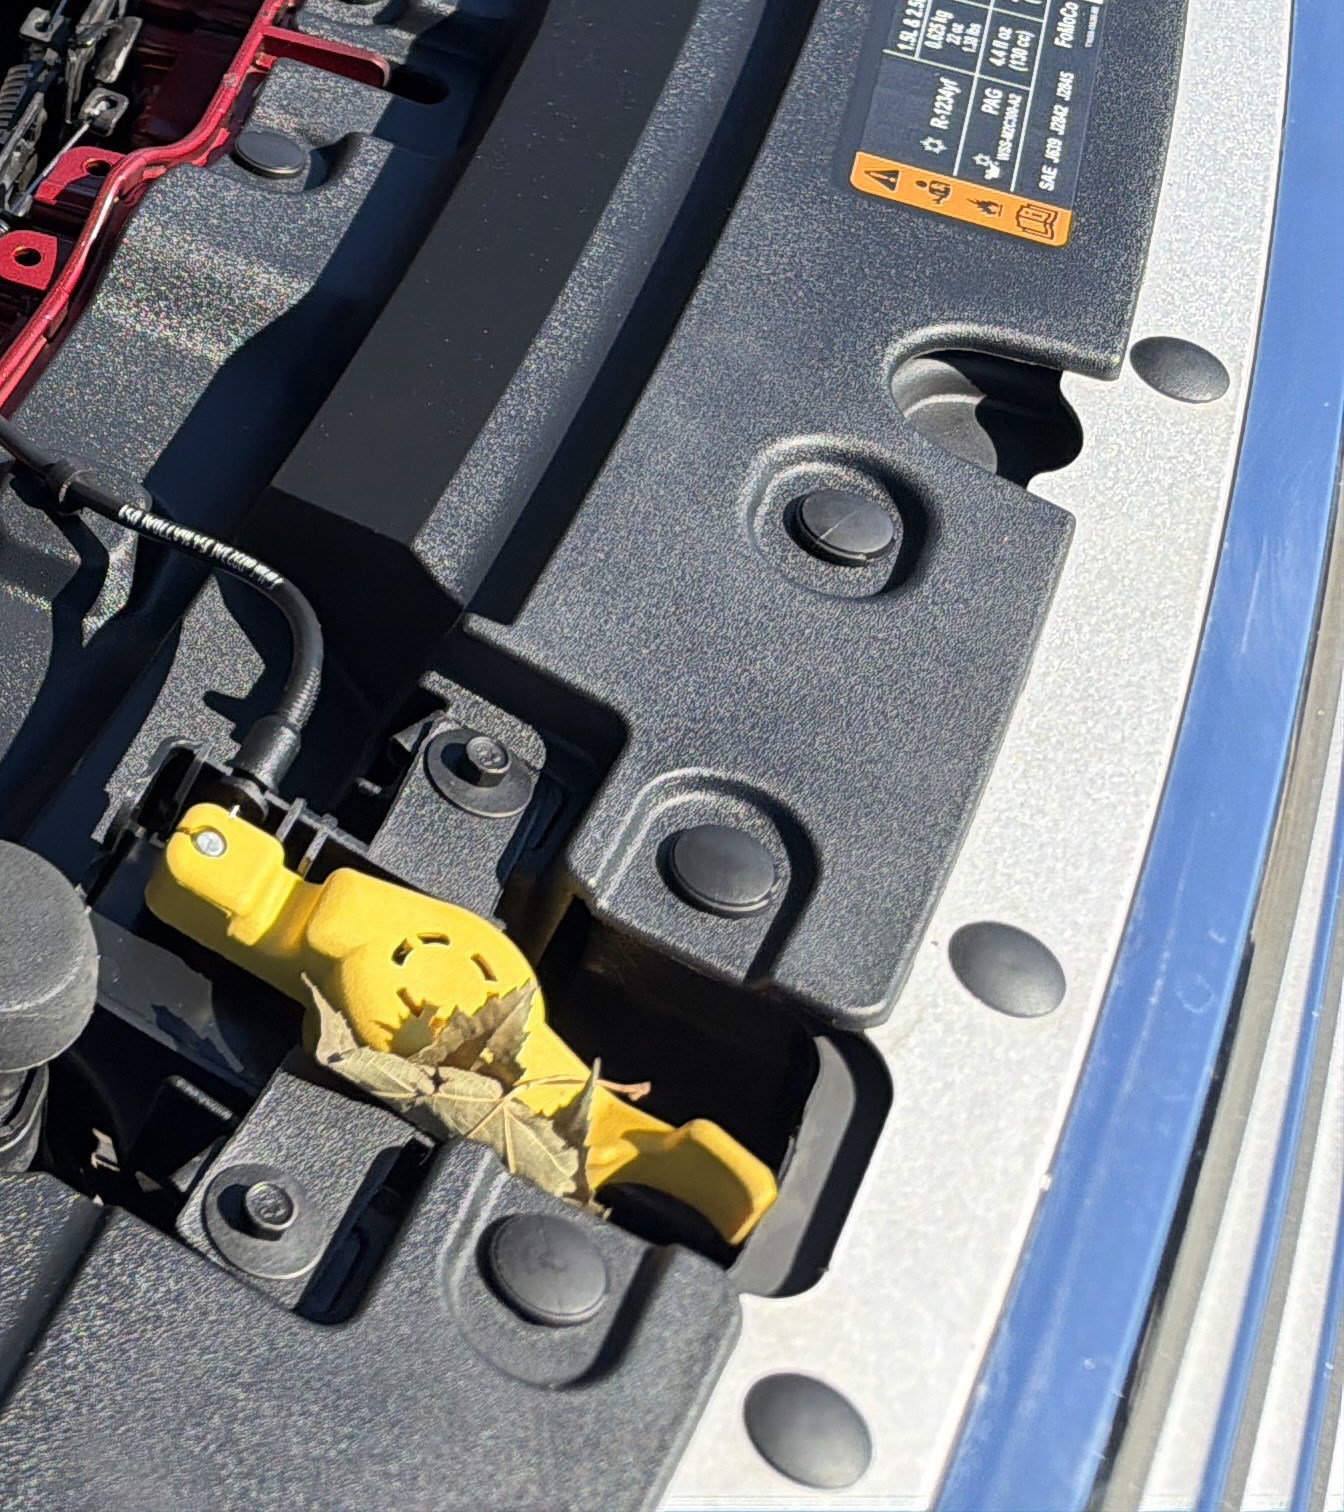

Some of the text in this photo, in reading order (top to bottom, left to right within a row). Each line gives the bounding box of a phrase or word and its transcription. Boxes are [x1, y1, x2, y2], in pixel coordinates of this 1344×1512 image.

[998, 26, 1012, 40] oz
[1054, 2, 1080, 49] FoMoCo
[897, 30, 918, 50] 1.5L
[1008, 30, 1036, 71] (130 cc)
[989, 49, 1008, 66] 4.4
[930, 77, 961, 129] R-1234yf
[981, 88, 1003, 115] PAG
[1045, 137, 1062, 163] J639
[1039, 165, 1058, 191] SAE
